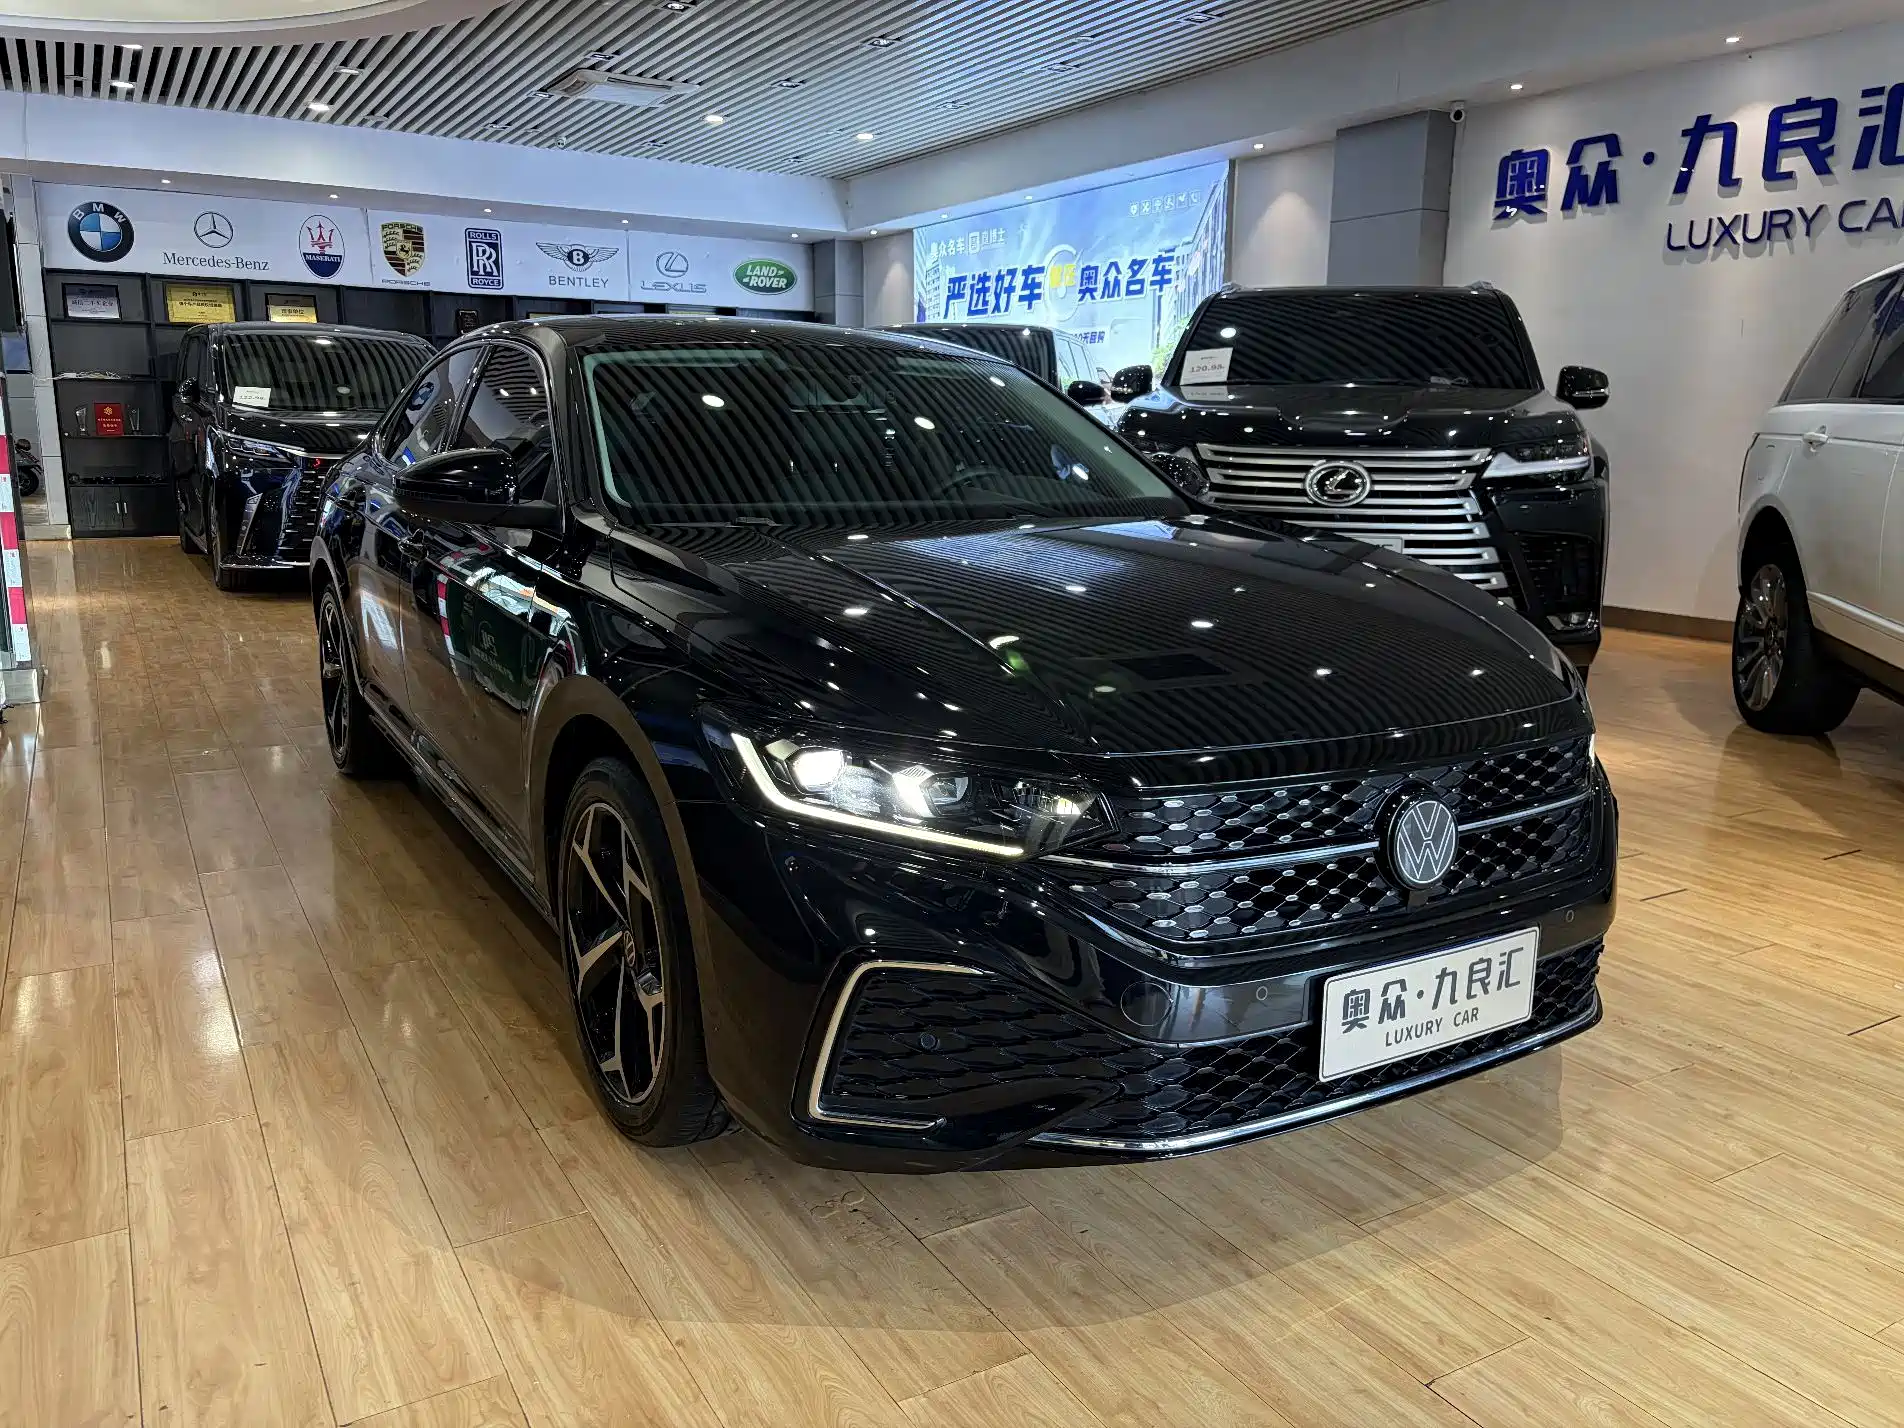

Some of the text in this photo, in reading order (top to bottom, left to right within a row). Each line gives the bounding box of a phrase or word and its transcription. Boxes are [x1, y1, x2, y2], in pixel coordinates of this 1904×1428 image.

[72, 203, 127, 223] BMW
[381, 223, 424, 234] PORSCHE
[1666, 197, 1904, 251] LUXURY CA
[469, 231, 498, 241] ROLLS
[162, 251, 269, 271] Mercedes-Benz
[304, 253, 342, 264] MASERATI
[745, 266, 778, 278] LAND
[381, 277, 431, 287] PORSCHE
[472, 277, 500, 287] ROYCE
[548, 275, 609, 289] BENTLEY
[640, 280, 707, 294] LEXUS
[749, 275, 788, 290] ROVER
[944, 264, 1046, 320] 严选好车
[1077, 247, 1176, 302] 奥众名车
[1341, 946, 1524, 1033] 奥众·九良汇
[1385, 1007, 1479, 1047] LUXURY CAR
